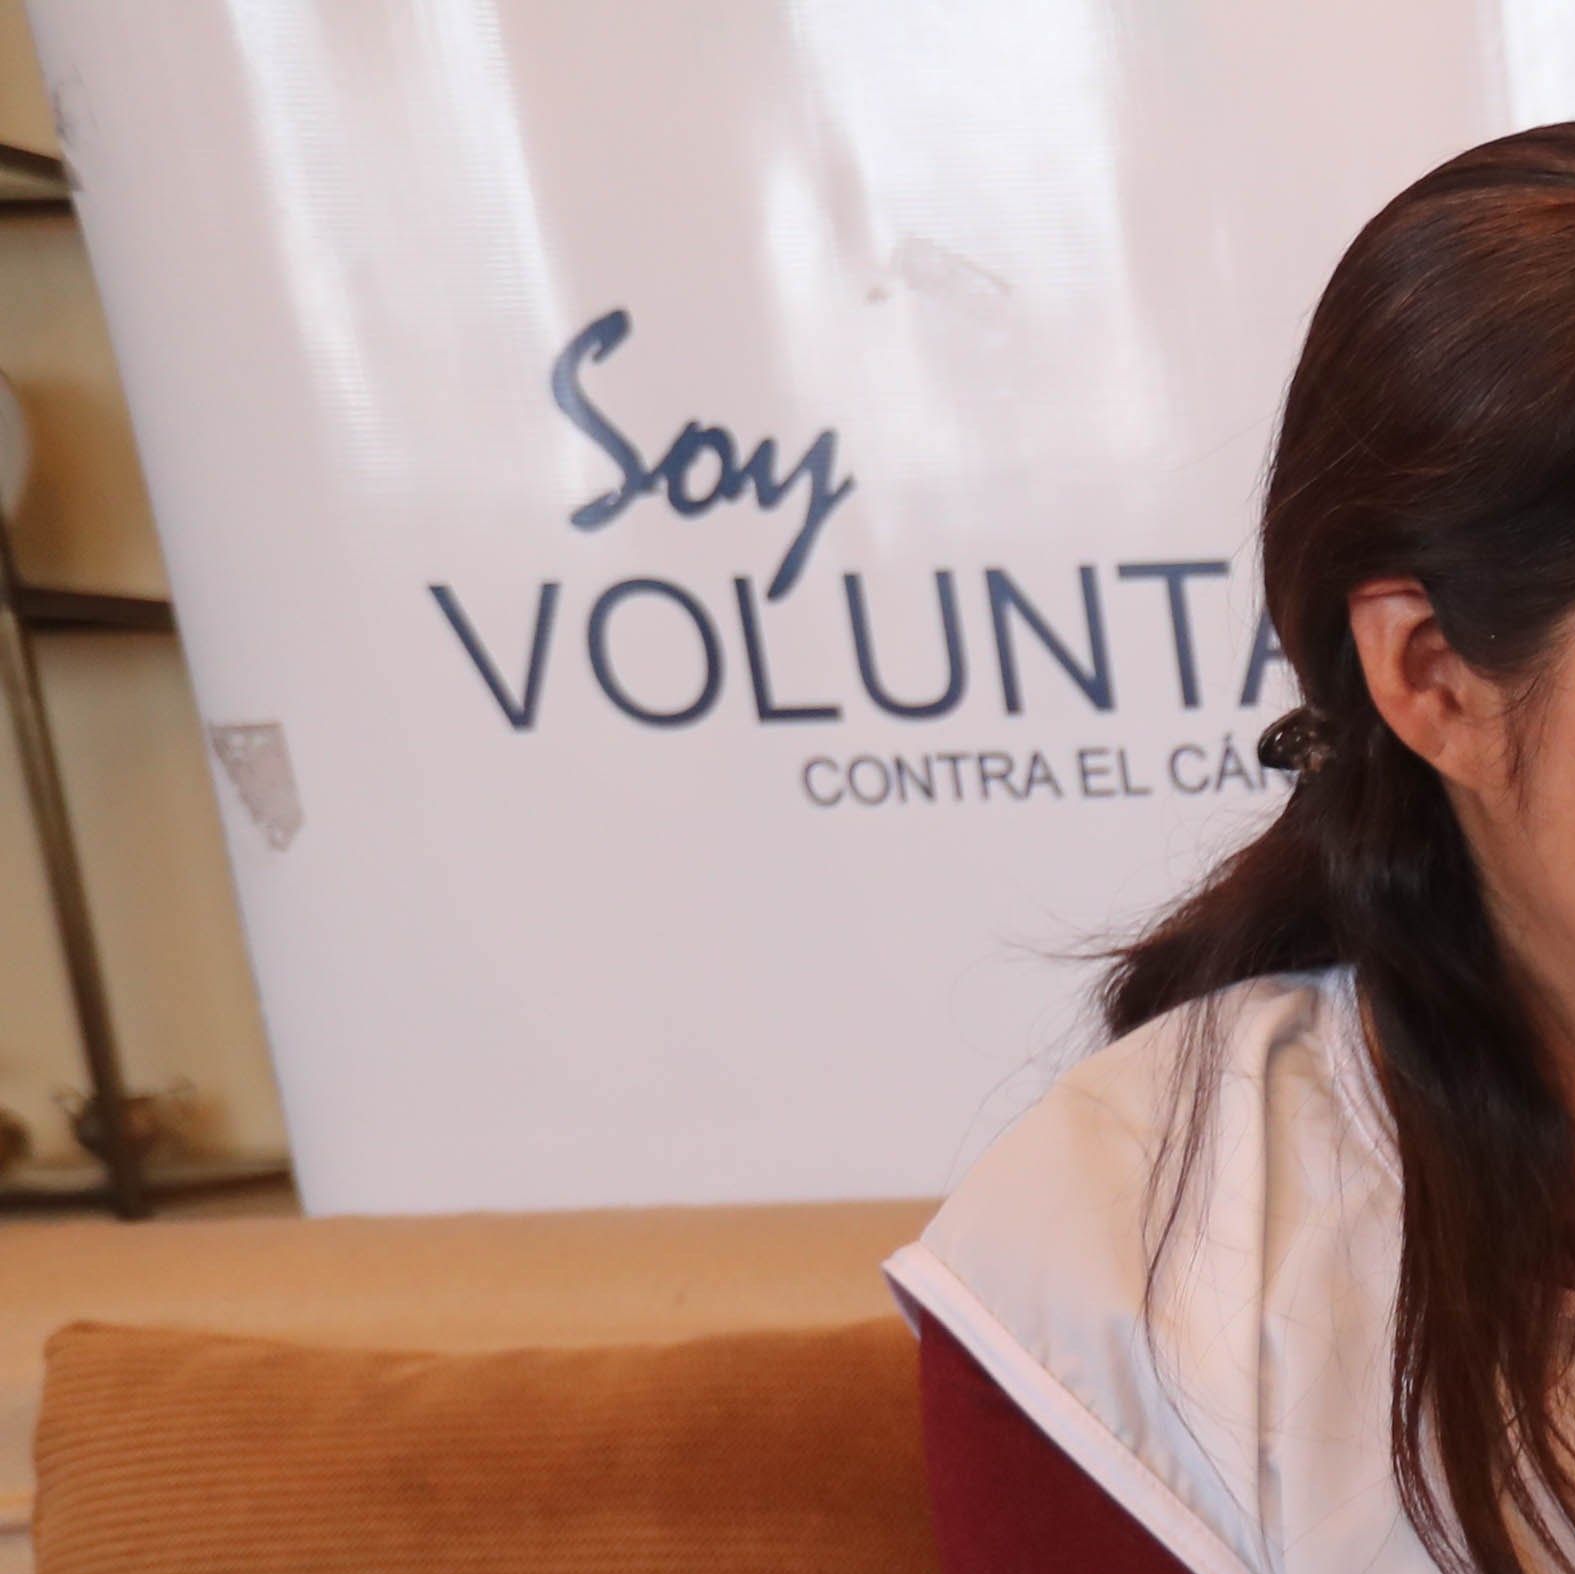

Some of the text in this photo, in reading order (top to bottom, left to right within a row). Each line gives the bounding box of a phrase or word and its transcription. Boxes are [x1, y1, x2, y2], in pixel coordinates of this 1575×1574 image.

[552, 308, 854, 602] Soy
[803, 752, 1062, 807] CONTRA
[1079, 747, 1154, 798] EL
